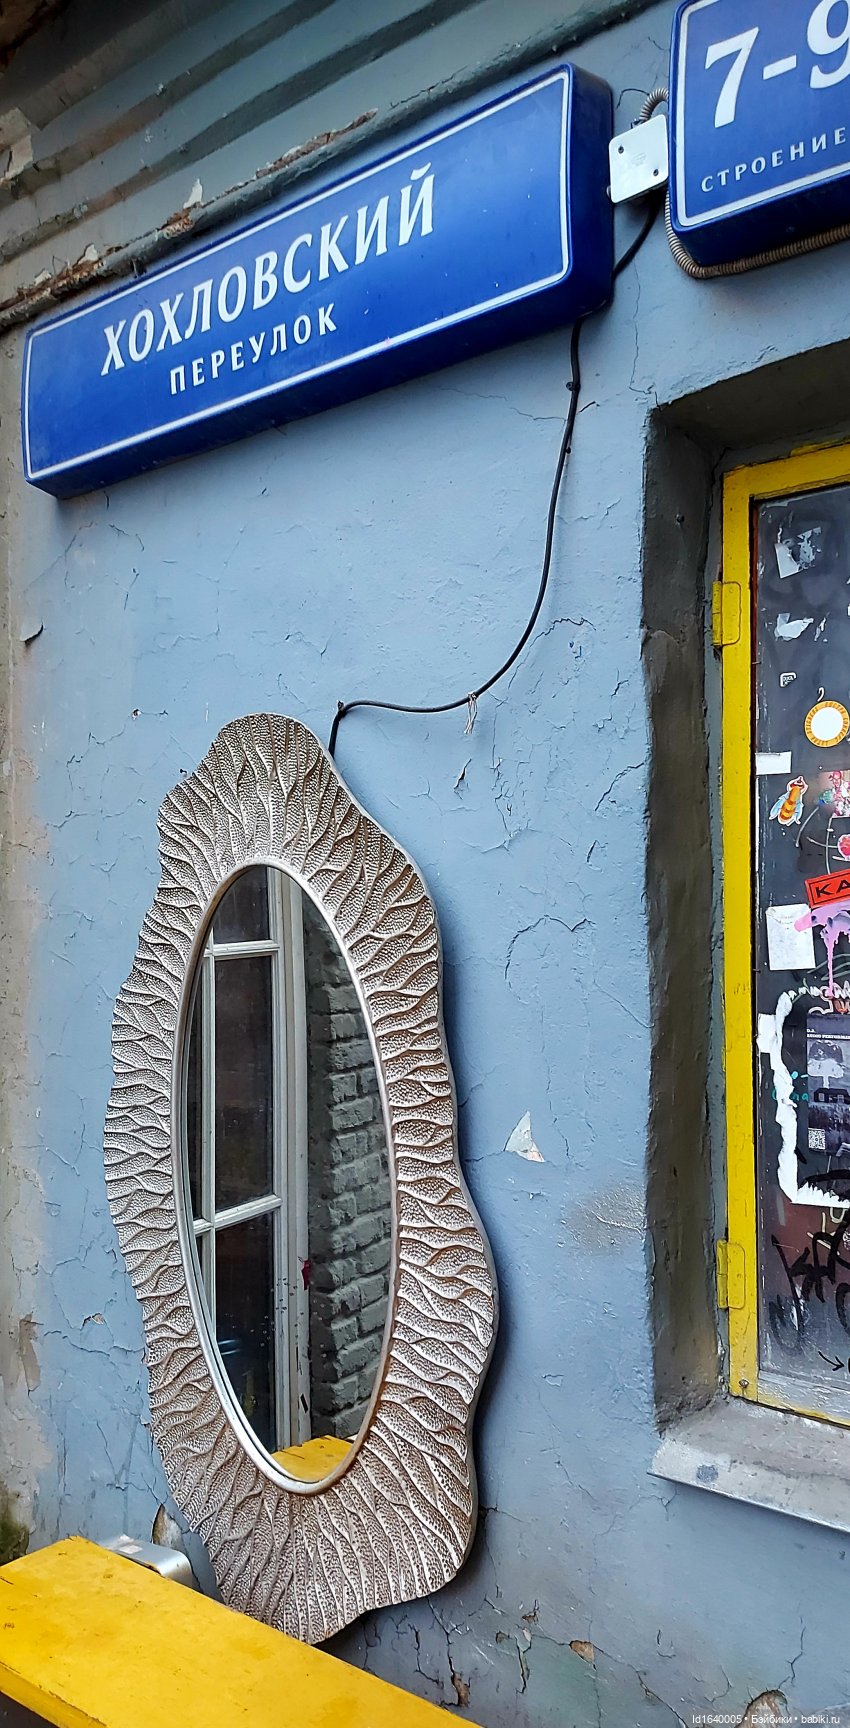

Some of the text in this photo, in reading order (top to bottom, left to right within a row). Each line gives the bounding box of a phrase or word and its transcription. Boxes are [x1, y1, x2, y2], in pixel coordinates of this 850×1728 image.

[701, 127, 846, 193] СТРОЕНИЕ
[100, 162, 436, 376] ХОХЛОВСКИЙ
[169, 303, 337, 396] ПЕРЕУЛОК
